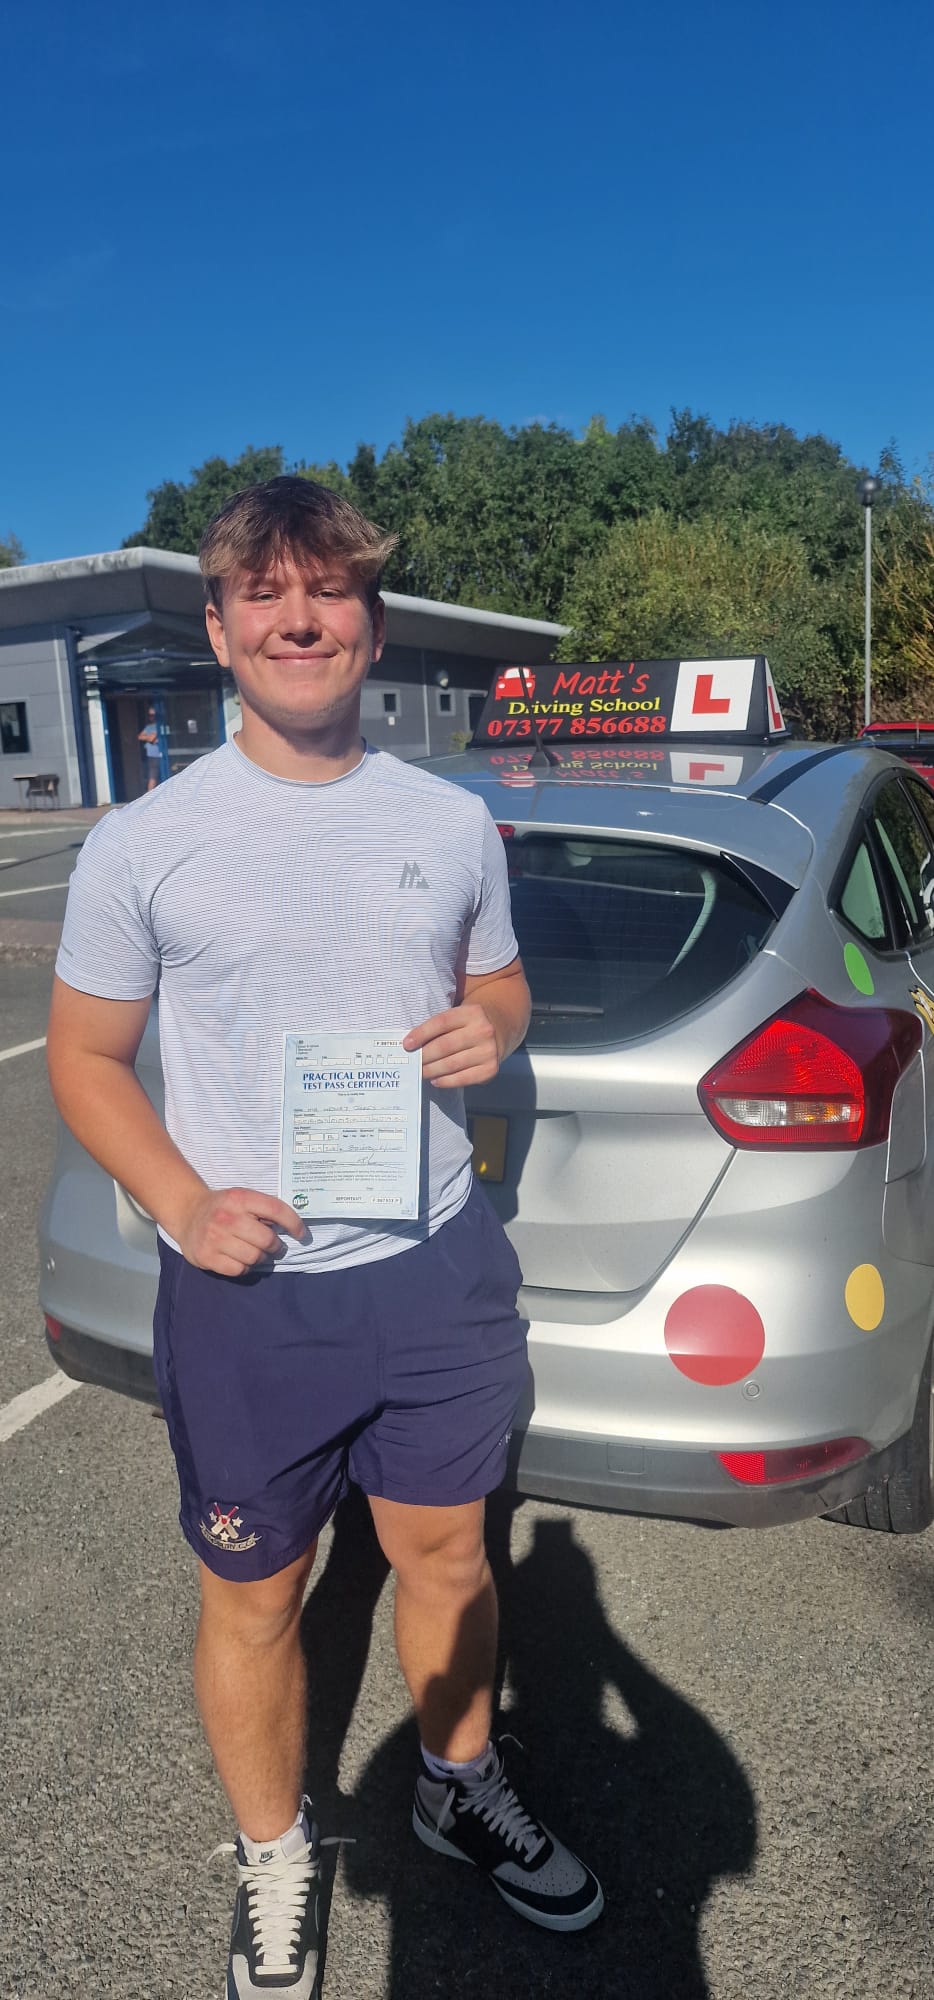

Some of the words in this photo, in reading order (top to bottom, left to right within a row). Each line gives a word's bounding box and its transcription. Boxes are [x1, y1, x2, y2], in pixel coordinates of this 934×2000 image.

[552, 662, 650, 696] Matt's
[589, 696, 661, 713] School
[691, 674, 731, 714] L
[767, 685, 782, 729] L
[487, 718, 563, 737] 07377
[569, 716, 667, 736] 856688
[303, 1072, 354, 1081] PRACTICAL
[357, 1071, 400, 1080] DRIVING
[347, 1080, 400, 1089] CERTIFICATE
